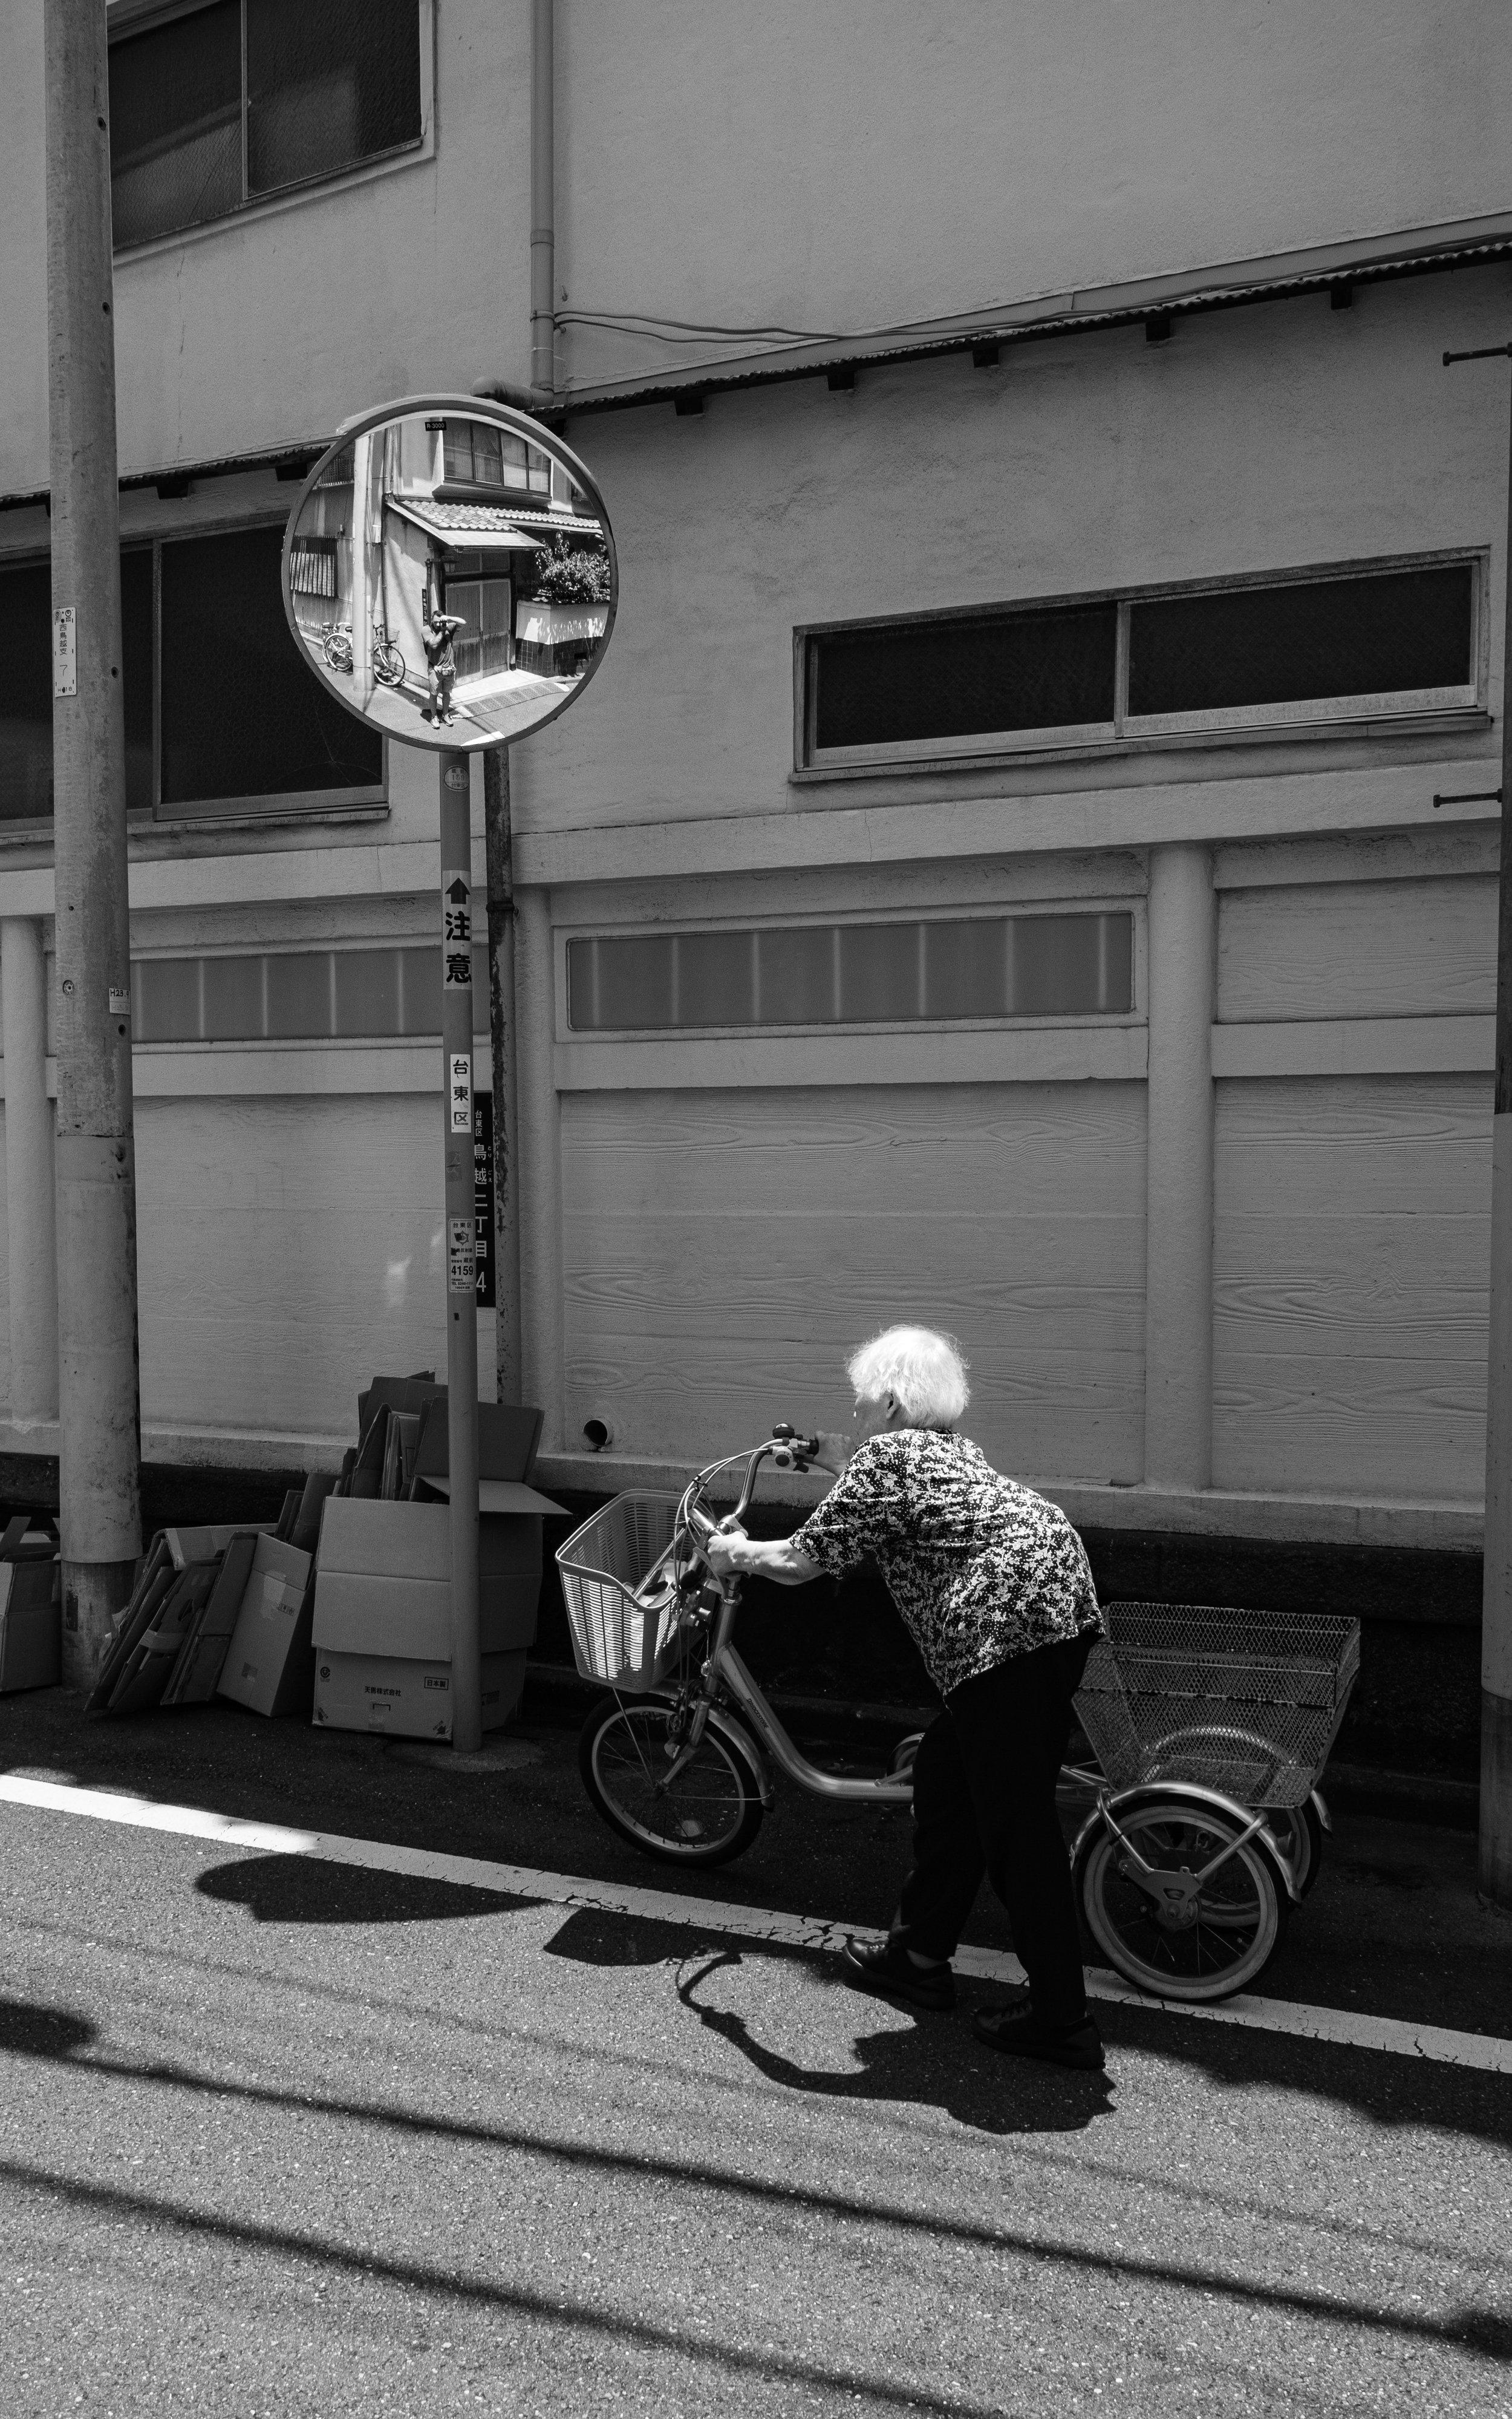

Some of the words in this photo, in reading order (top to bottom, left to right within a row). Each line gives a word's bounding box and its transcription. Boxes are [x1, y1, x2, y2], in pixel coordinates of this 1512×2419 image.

[446, 910, 471, 983] 注意
[453, 1059, 469, 1125] 台東区
[487, 1146, 492, 1158] とり
[474, 1143, 488, 1258] 鳥越二丁目
[451, 1265, 474, 1276] 4159
[476, 1272, 487, 1293] 4
[746, 1698, 769, 1728] BRIDGESTONE
